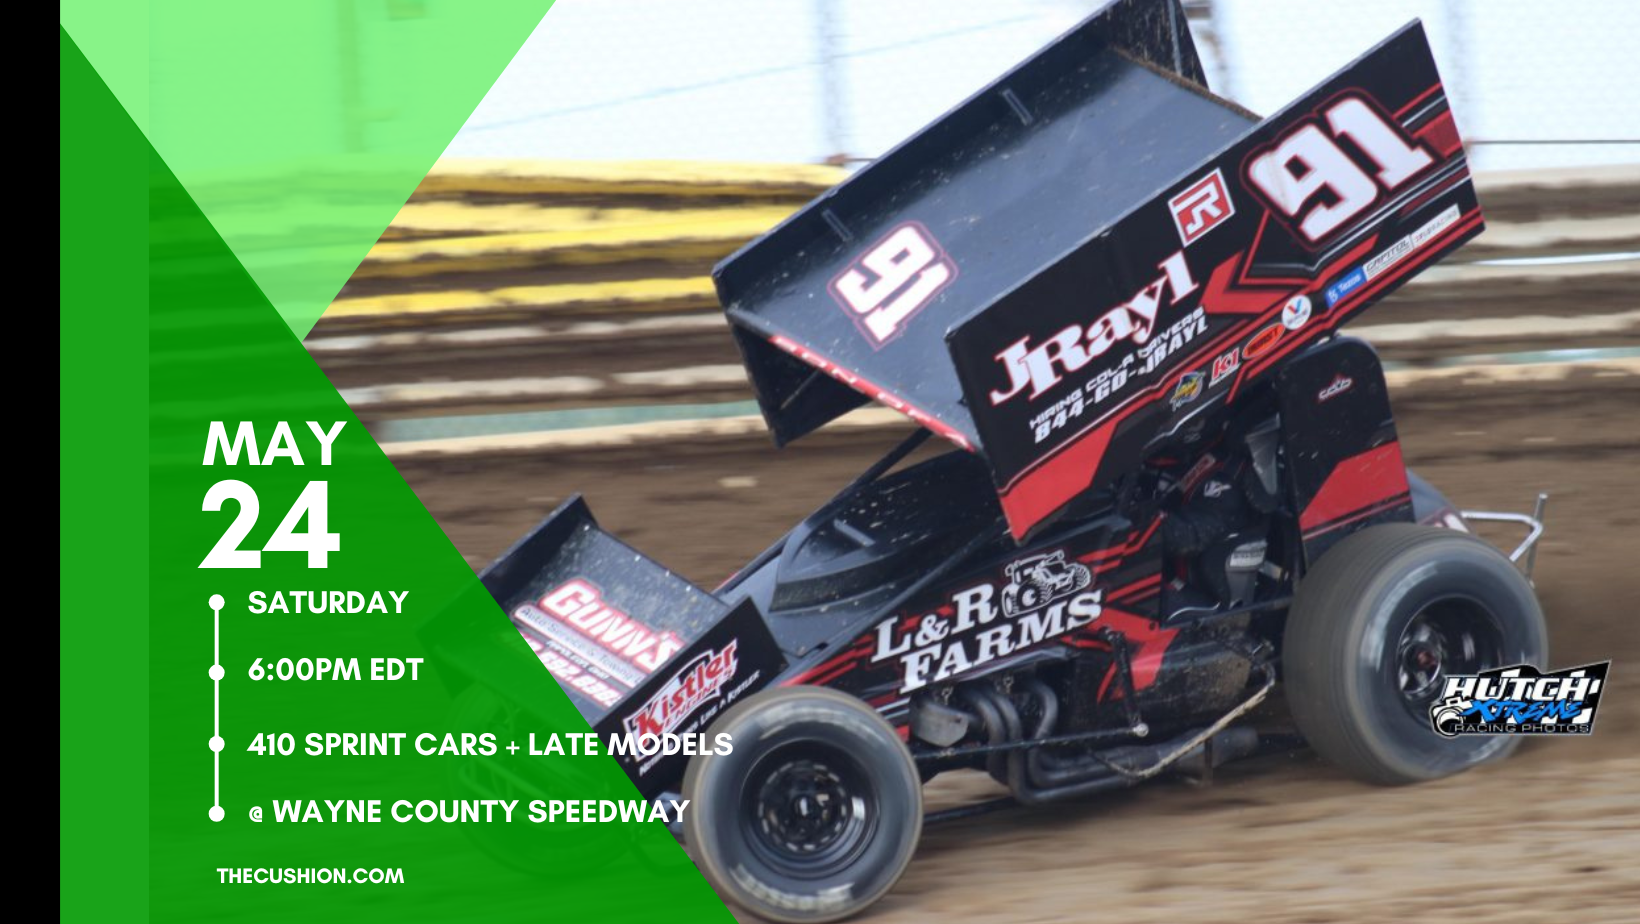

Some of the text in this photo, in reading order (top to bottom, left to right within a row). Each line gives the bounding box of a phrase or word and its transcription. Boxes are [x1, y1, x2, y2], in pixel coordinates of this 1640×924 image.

[1247, 97, 1436, 242] 91
[833, 223, 953, 345] 91
[989, 249, 1200, 406] JRayl
[1029, 387, 1082, 430] HIRING
[1137, 305, 1205, 359] DRIVERS
[871, 583, 998, 663] L&R
[899, 589, 1102, 694] FARMS
[632, 640, 737, 749] Kistler
